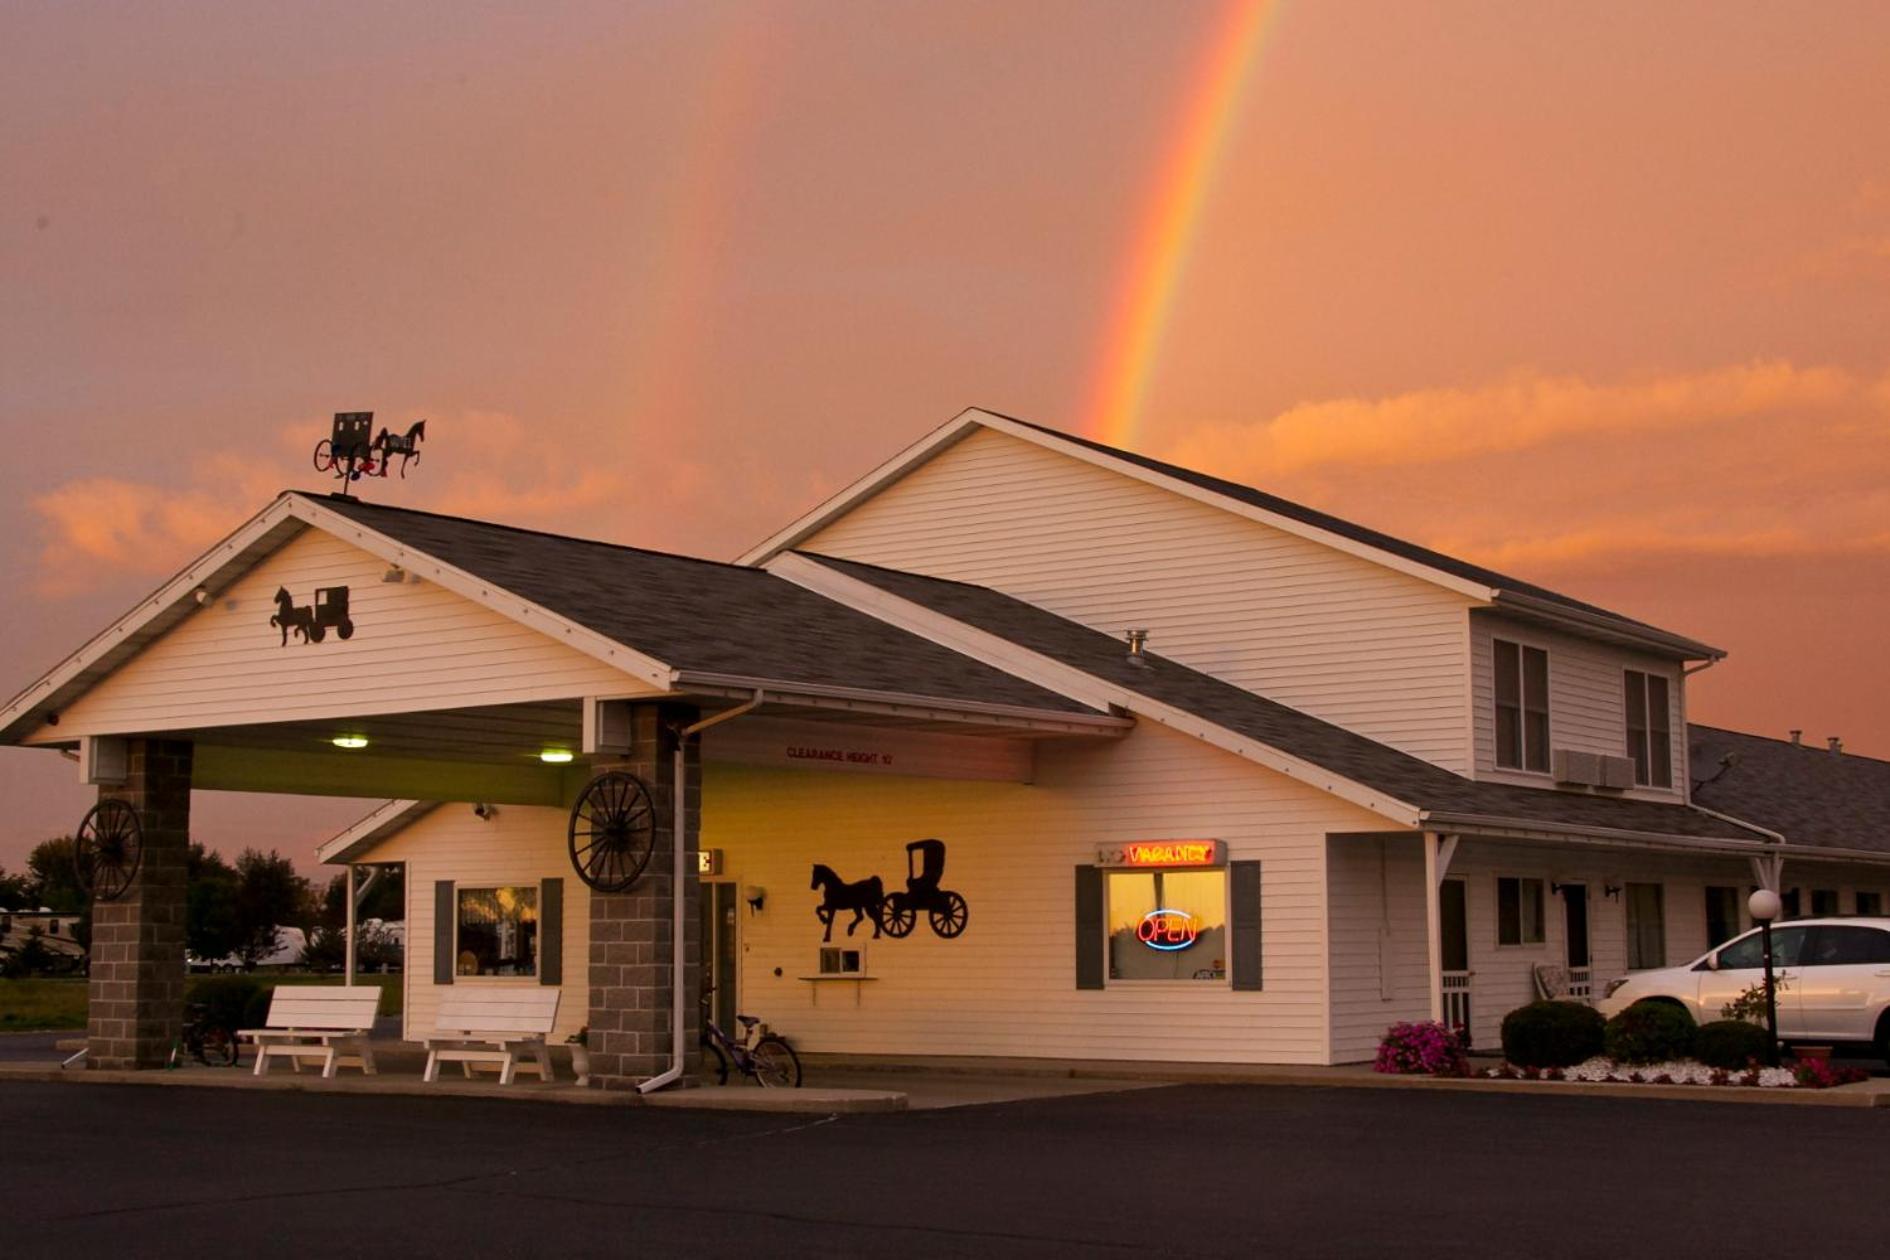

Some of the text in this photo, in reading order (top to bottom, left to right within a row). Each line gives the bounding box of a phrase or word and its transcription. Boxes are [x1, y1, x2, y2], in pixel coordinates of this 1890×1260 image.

[786, 746, 843, 762] CLEARANCE
[846, 751, 877, 764] HEIGHT
[1129, 844, 1211, 863] VACANCY
[1138, 917, 1198, 941] OPEN
